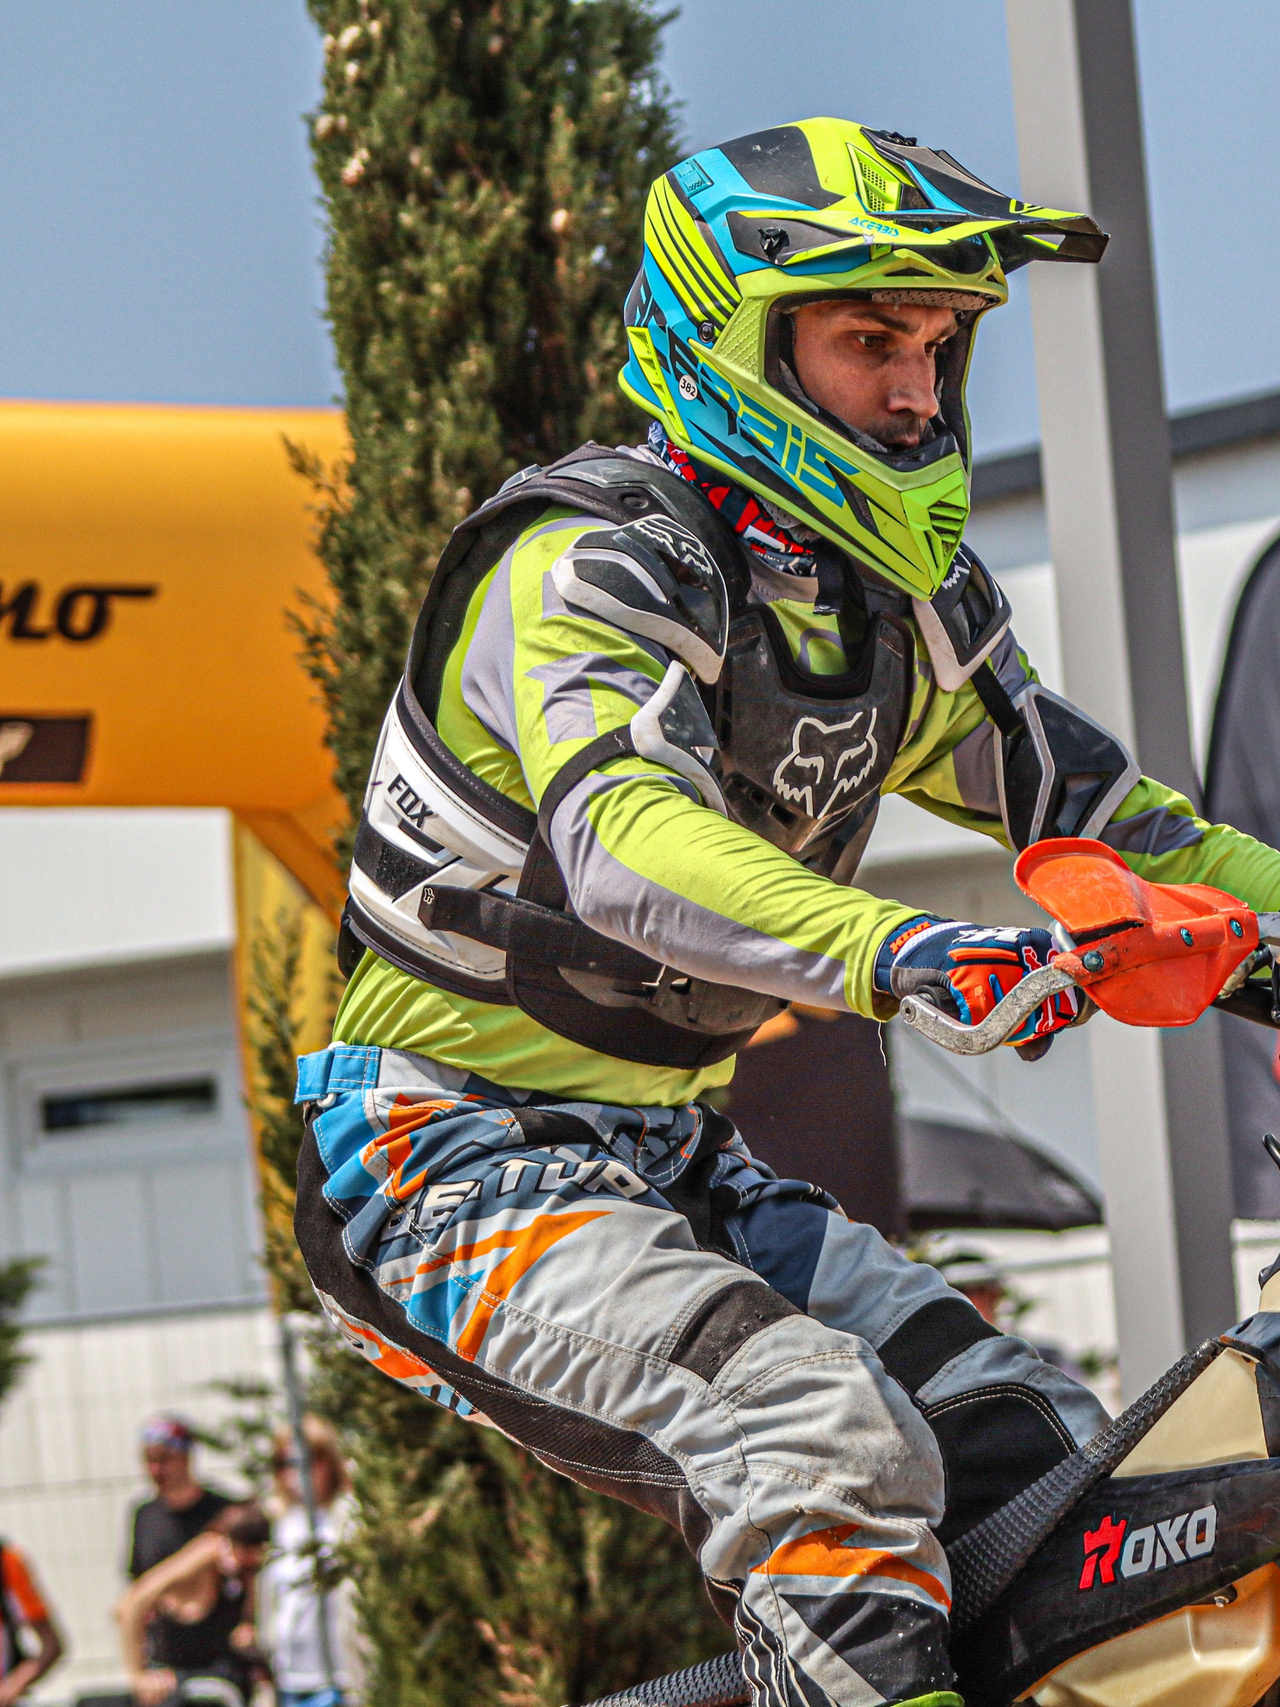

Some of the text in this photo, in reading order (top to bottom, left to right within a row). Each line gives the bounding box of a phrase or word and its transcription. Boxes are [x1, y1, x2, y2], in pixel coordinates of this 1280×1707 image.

[680, 378, 697, 398] 382
[388, 773, 434, 828] FOX
[890, 921, 931, 954] KINI
